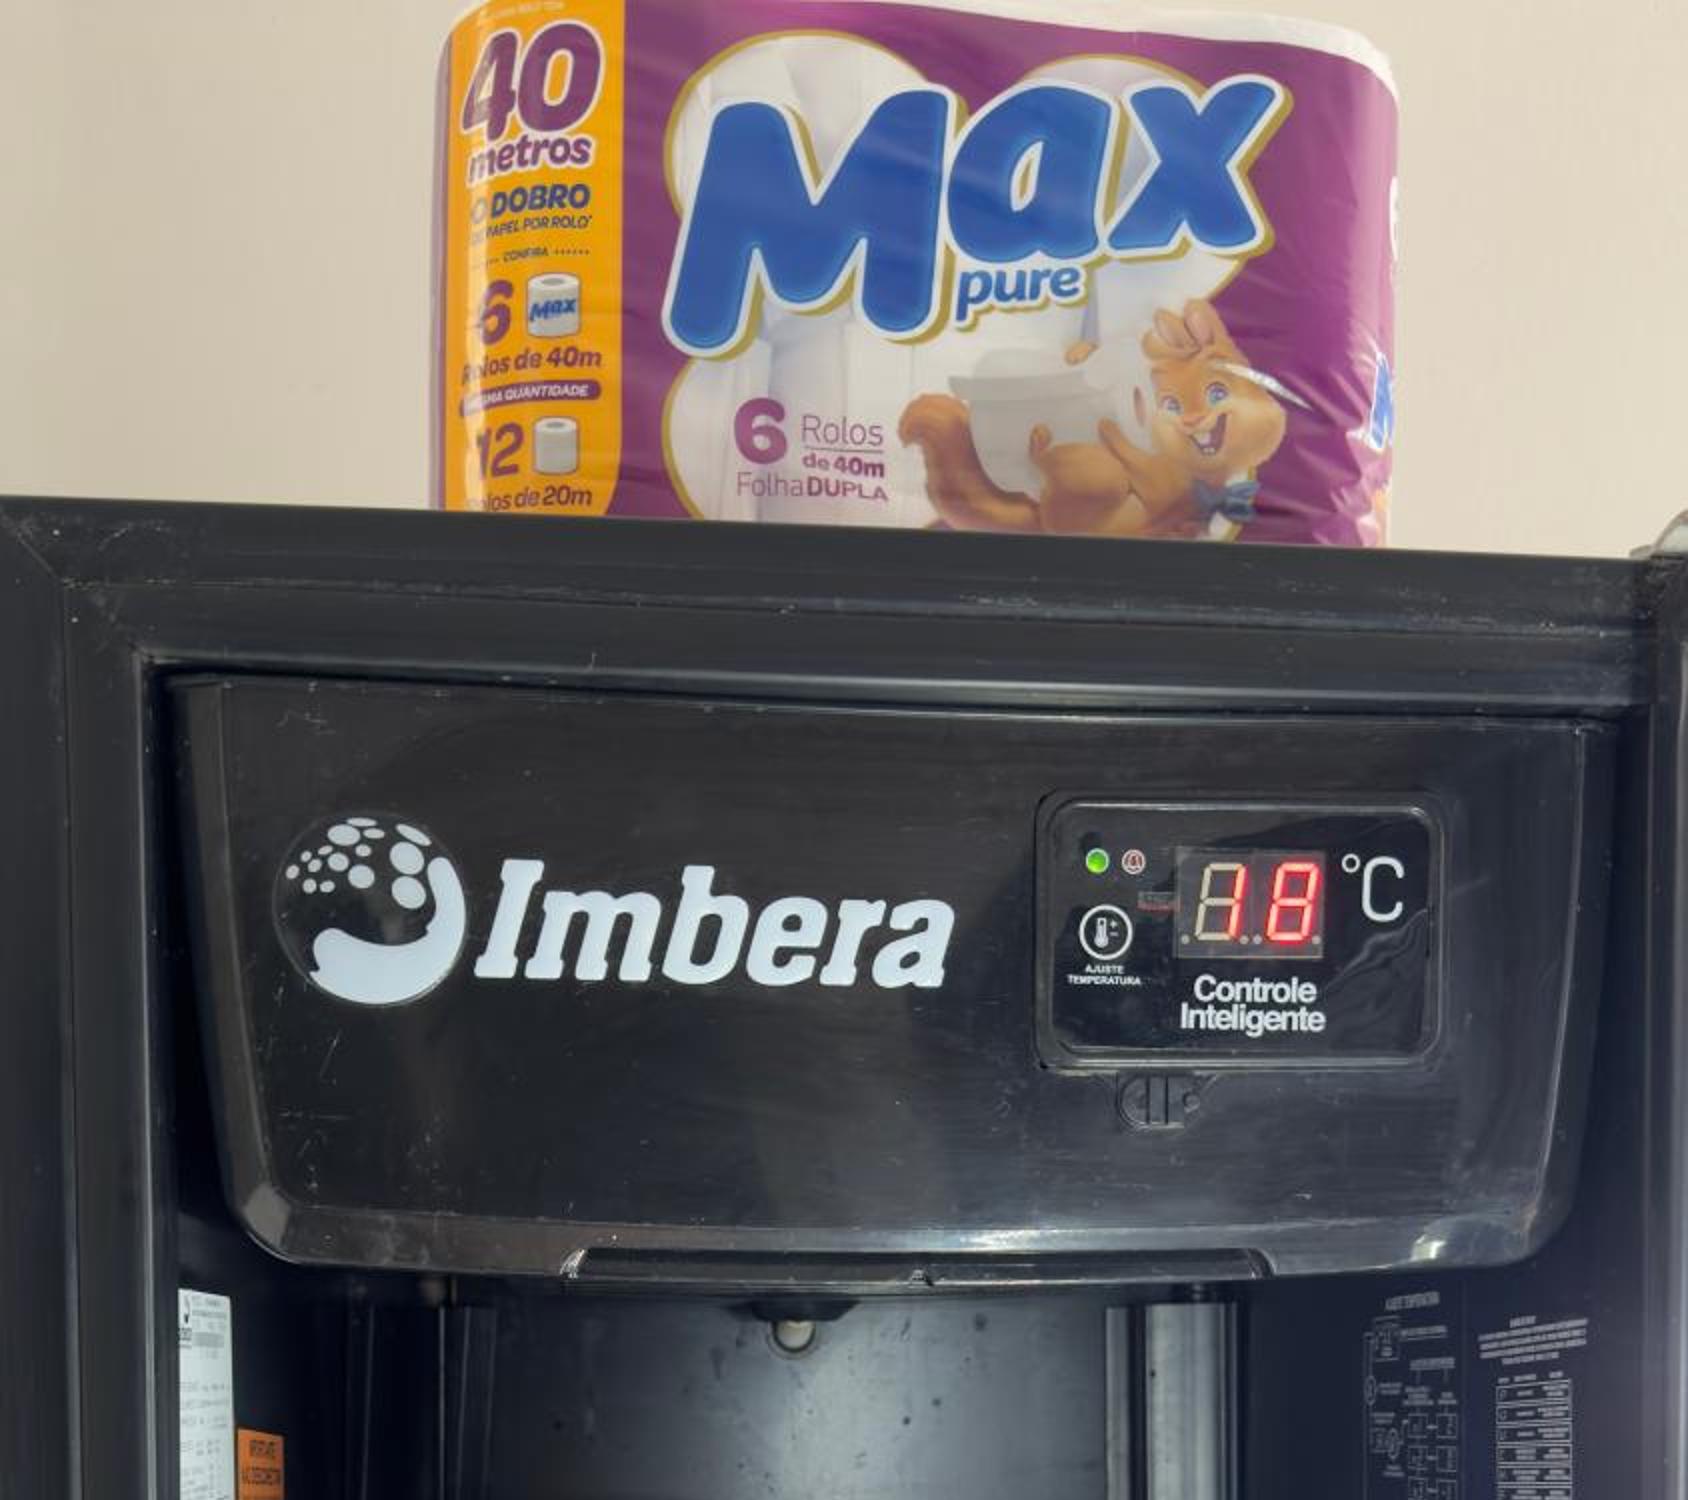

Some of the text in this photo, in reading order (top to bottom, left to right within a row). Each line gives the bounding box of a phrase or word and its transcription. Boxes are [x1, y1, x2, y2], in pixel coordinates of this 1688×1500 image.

[461, 22, 603, 140] 40
[468, 138, 593, 183] metros
[490, 182, 591, 219] DOBRO
[664, 74, 1286, 356] Max
[955, 262, 1081, 321] pure
[479, 280, 578, 345] 6 Max
[514, 347, 541, 370] de
[545, 346, 602, 367] 40m
[505, 383, 589, 400] QUANTIDADE
[733, 397, 884, 465] 6 Rolos
[802, 453, 885, 478] de 40m
[514, 485, 540, 508] de
[543, 484, 593, 506] 20m
[1226, 860, 1322, 943] 18
[473, 859, 957, 989] Imbera
[1067, 974, 1142, 986] TEMPERATURA
[1194, 975, 1318, 1003] Controle
[1180, 1003, 1327, 1037] Inteligente
